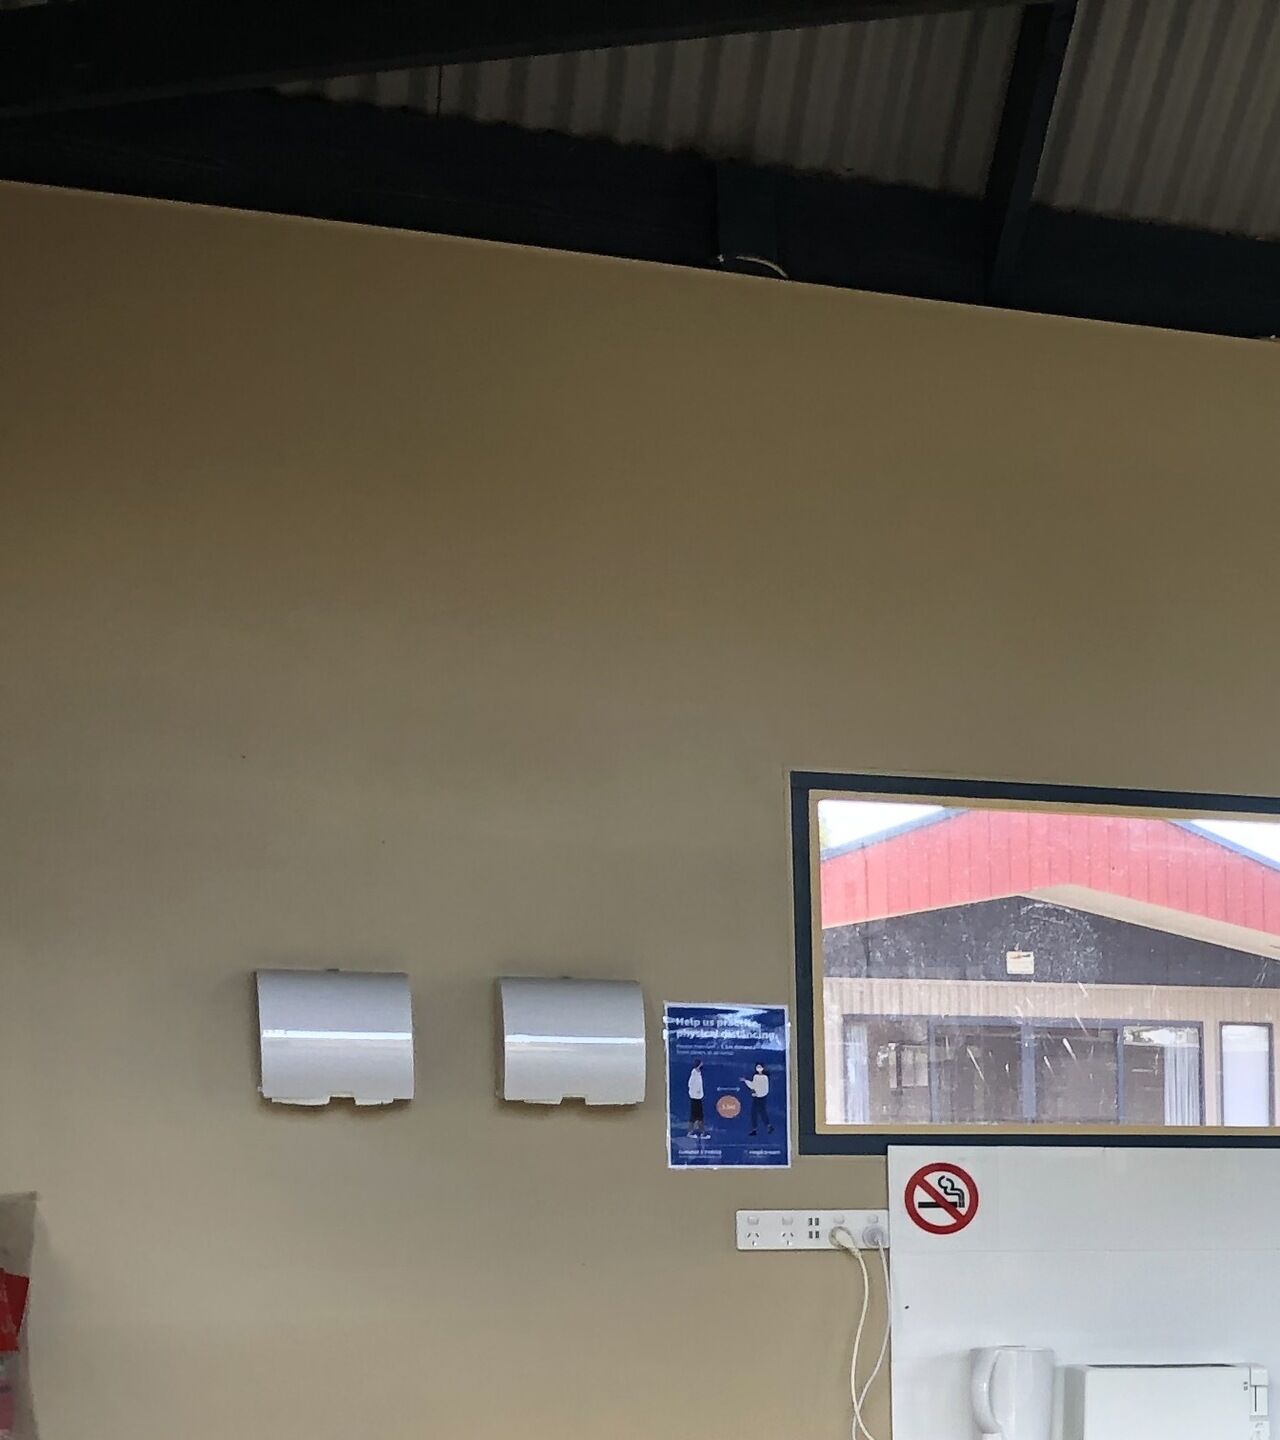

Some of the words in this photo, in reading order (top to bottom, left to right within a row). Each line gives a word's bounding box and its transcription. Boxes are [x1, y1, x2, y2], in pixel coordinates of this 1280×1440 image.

[676, 1018, 700, 1027] Help
[676, 1029, 718, 1039] physical
[721, 1029, 776, 1041] distancing
